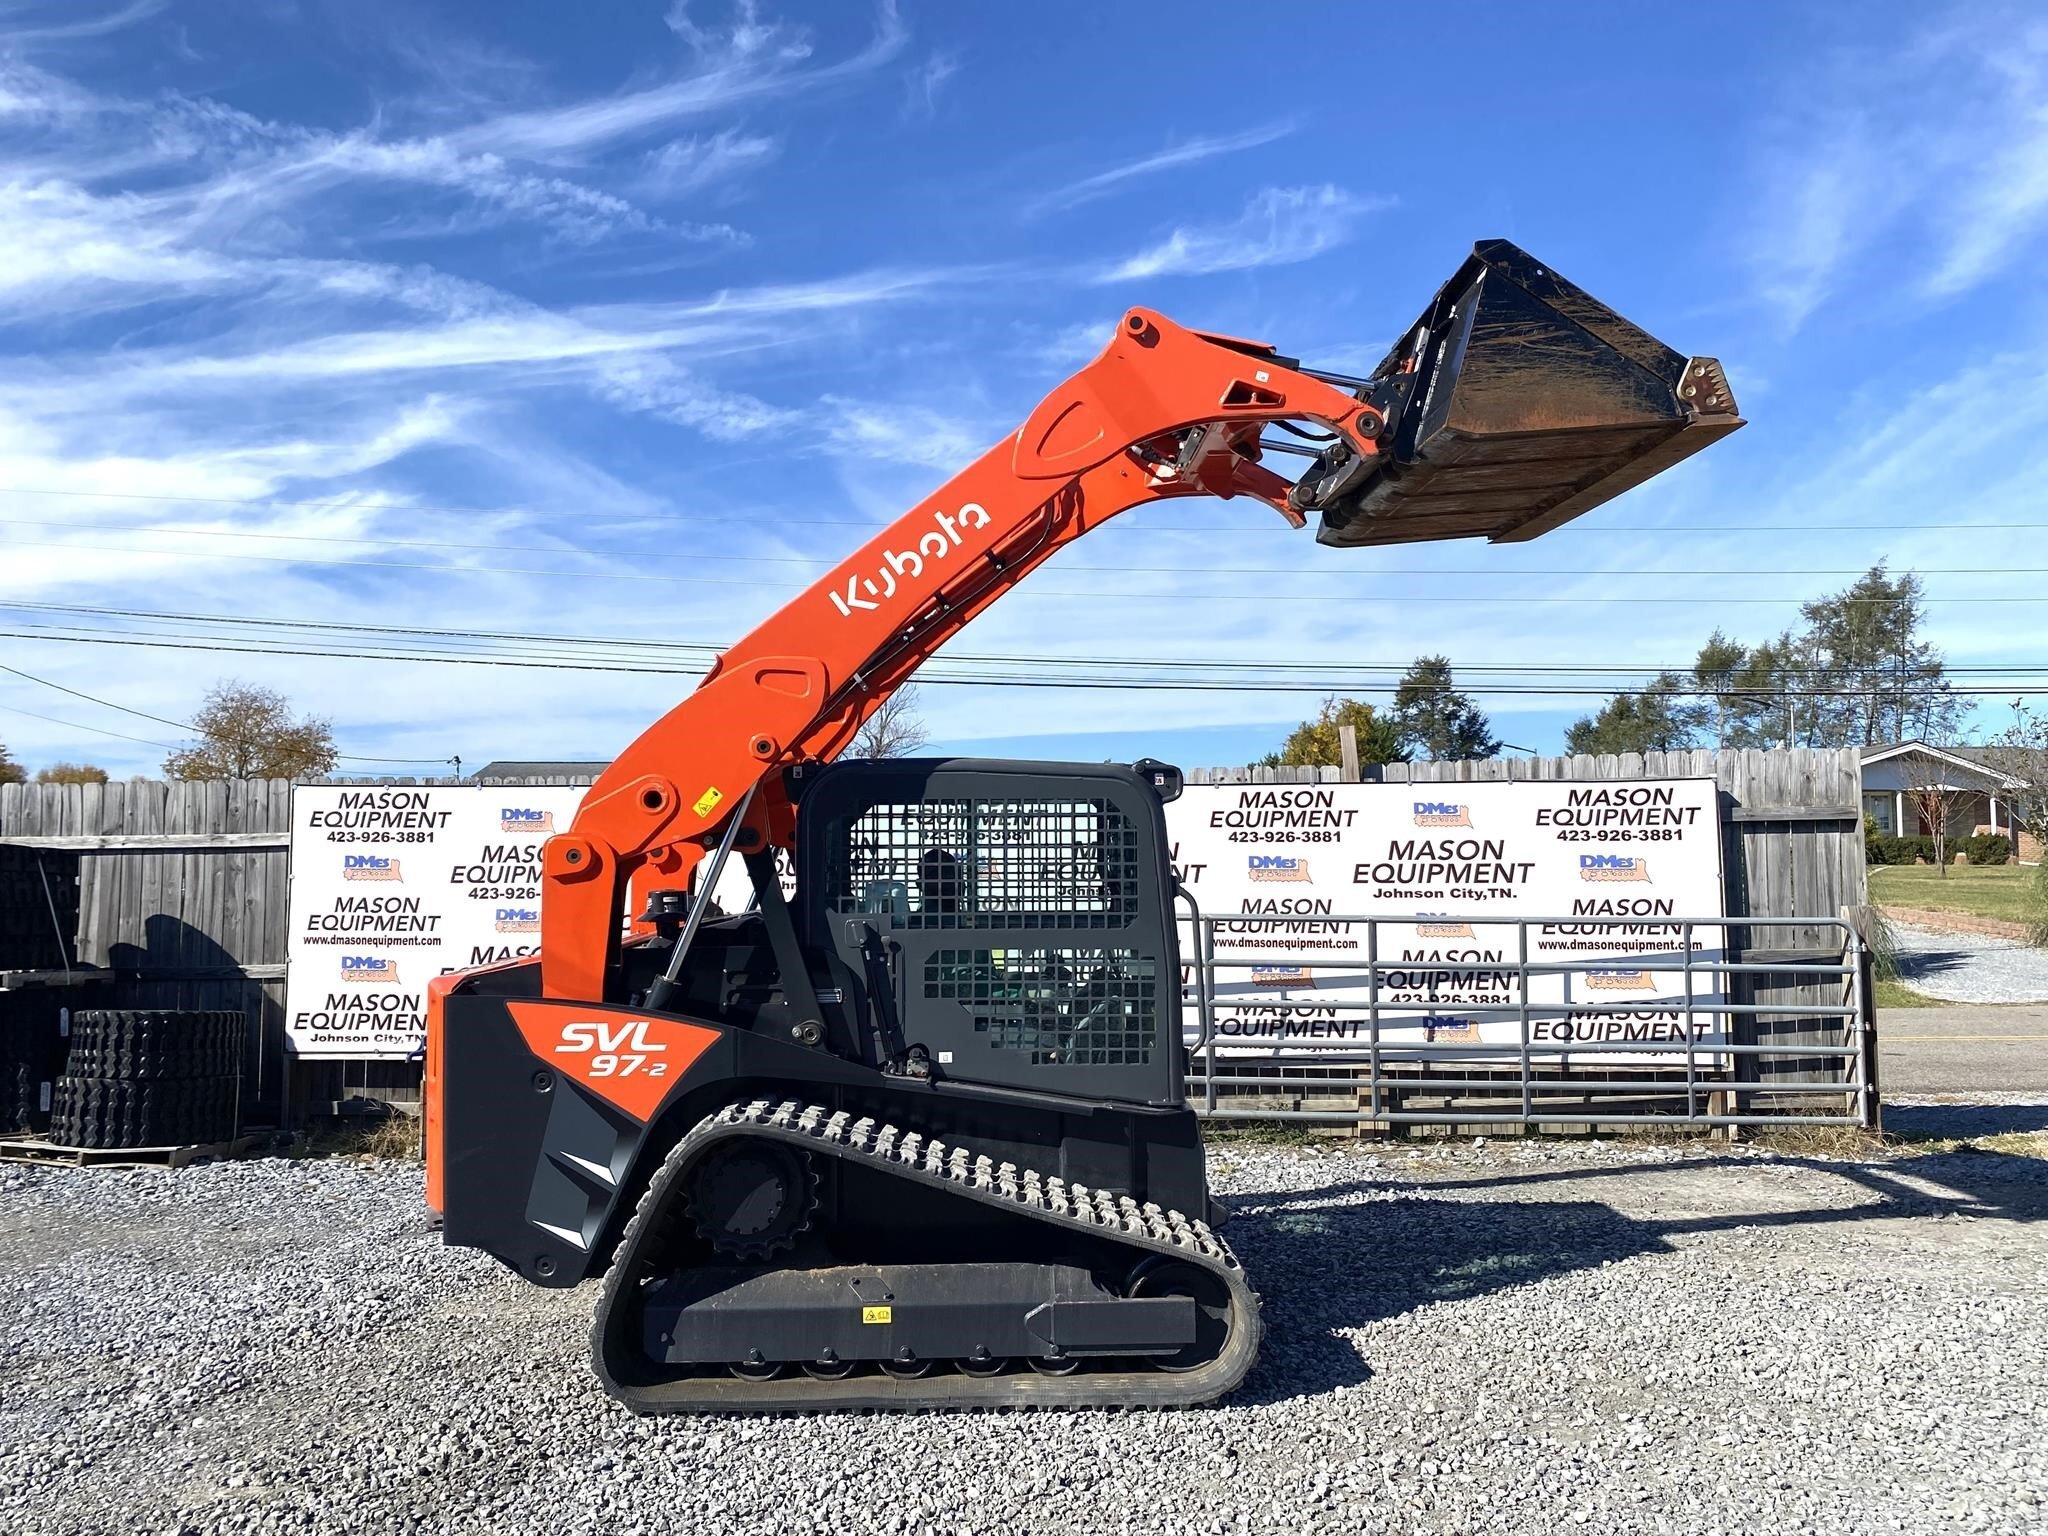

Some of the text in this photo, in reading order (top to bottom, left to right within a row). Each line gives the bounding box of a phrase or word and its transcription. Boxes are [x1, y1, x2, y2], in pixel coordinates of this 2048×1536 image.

[829, 502, 992, 617] Kubota
[338, 793, 430, 809] MASON
[1238, 791, 1334, 808] MASON
[1568, 788, 1674, 806] MASON
[309, 811, 452, 829] EQUIPMENT
[1209, 810, 1358, 828] EQUIPMENT
[1535, 807, 1702, 827] EQUIPMENT
[327, 831, 434, 843] 423-926-3881
[1228, 831, 1341, 843] 423-926-3881
[1556, 829, 1683, 842] 423-926-3881
[1388, 840, 1505, 860] MASON
[1352, 863, 1535, 884] EQUIPMENT
[1372, 888, 1518, 900] Johnson City,TN.
[334, 897, 420, 913] MASON
[1241, 899, 1332, 914] MASON
[1572, 899, 1674, 916] MASON
[307, 915, 441, 932] EQUIPMENT
[1541, 923, 1693, 935] EQUIPMEN
[303, 934, 442, 947] www.dmasonequipment.com
[1538, 939, 1703, 952] www.dmasonequipment.cm
[470, 946, 541, 965] MAS
[325, 993, 420, 1011] MASON
[310, 1033, 369, 1043] Johnson
[555, 1021, 668, 1052] SVL
[588, 1054, 669, 1077] 97-2
